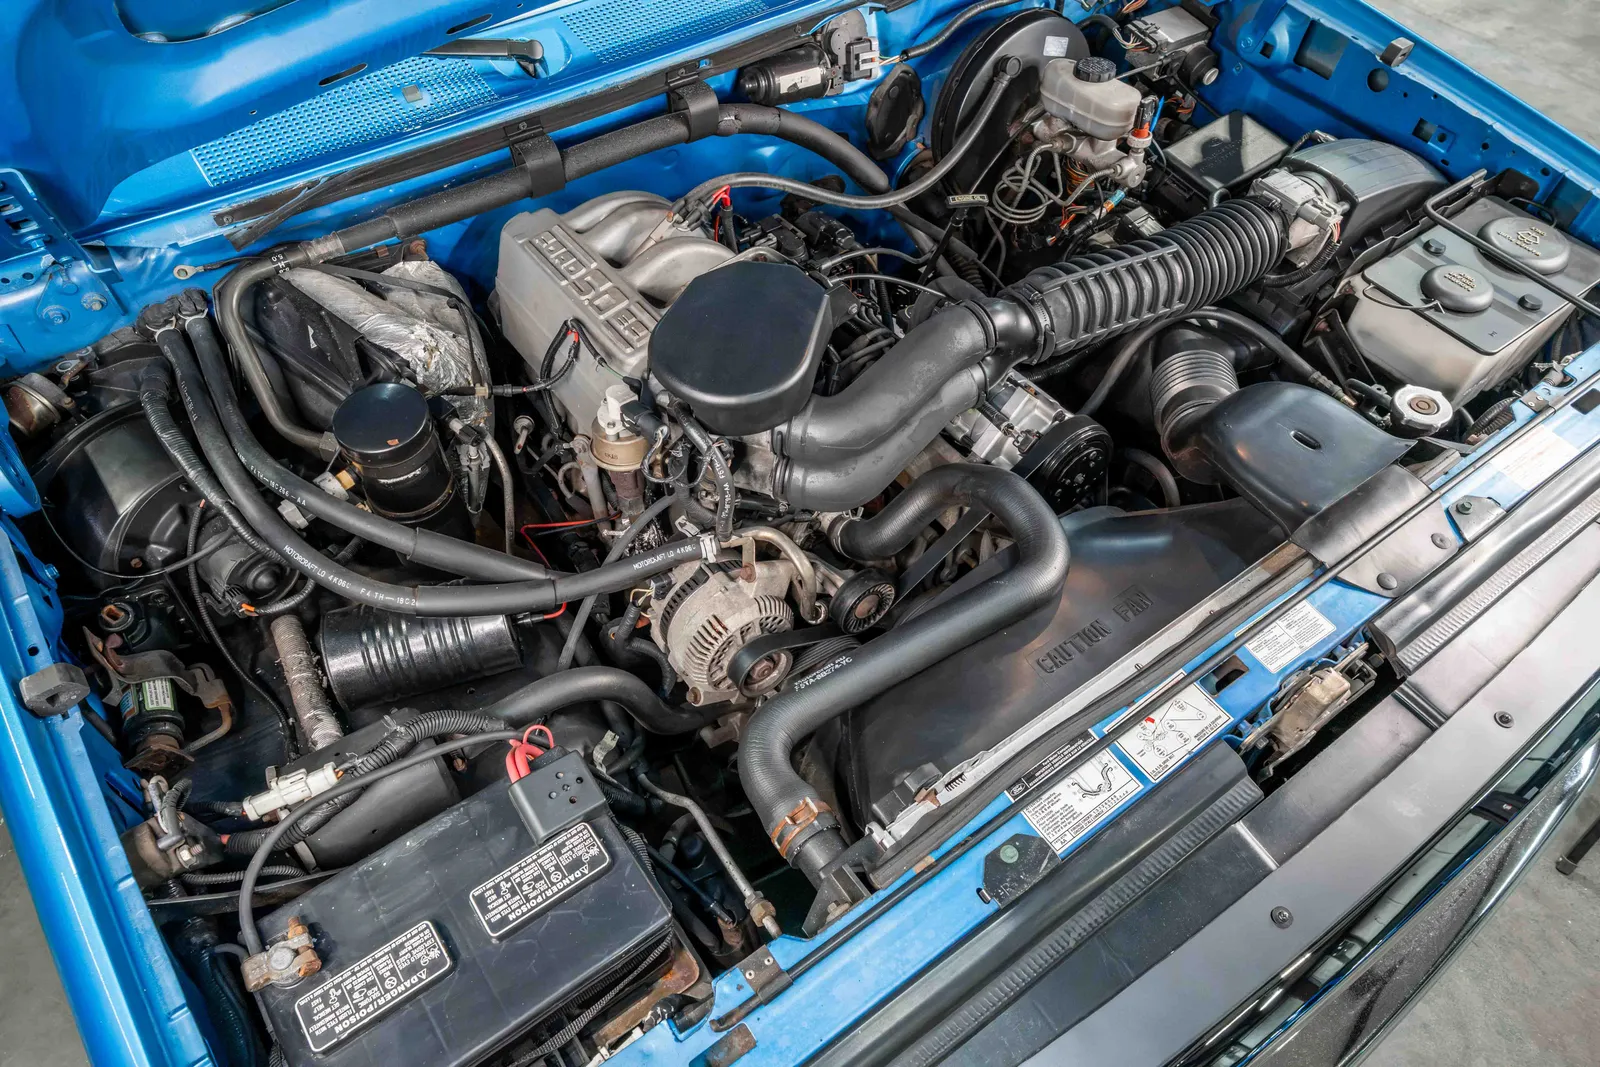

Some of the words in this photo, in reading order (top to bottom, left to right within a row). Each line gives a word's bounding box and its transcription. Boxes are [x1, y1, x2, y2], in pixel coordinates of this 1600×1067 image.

[282, 544, 317, 572] MOTORCRAFT
[632, 553, 665, 570] MOTORCRAFT
[1035, 615, 1112, 677] CAUTION
[1110, 587, 1153, 626] FAN
[506, 869, 582, 921] DANGER/POISON
[332, 974, 420, 1034] DANGER/POISON
